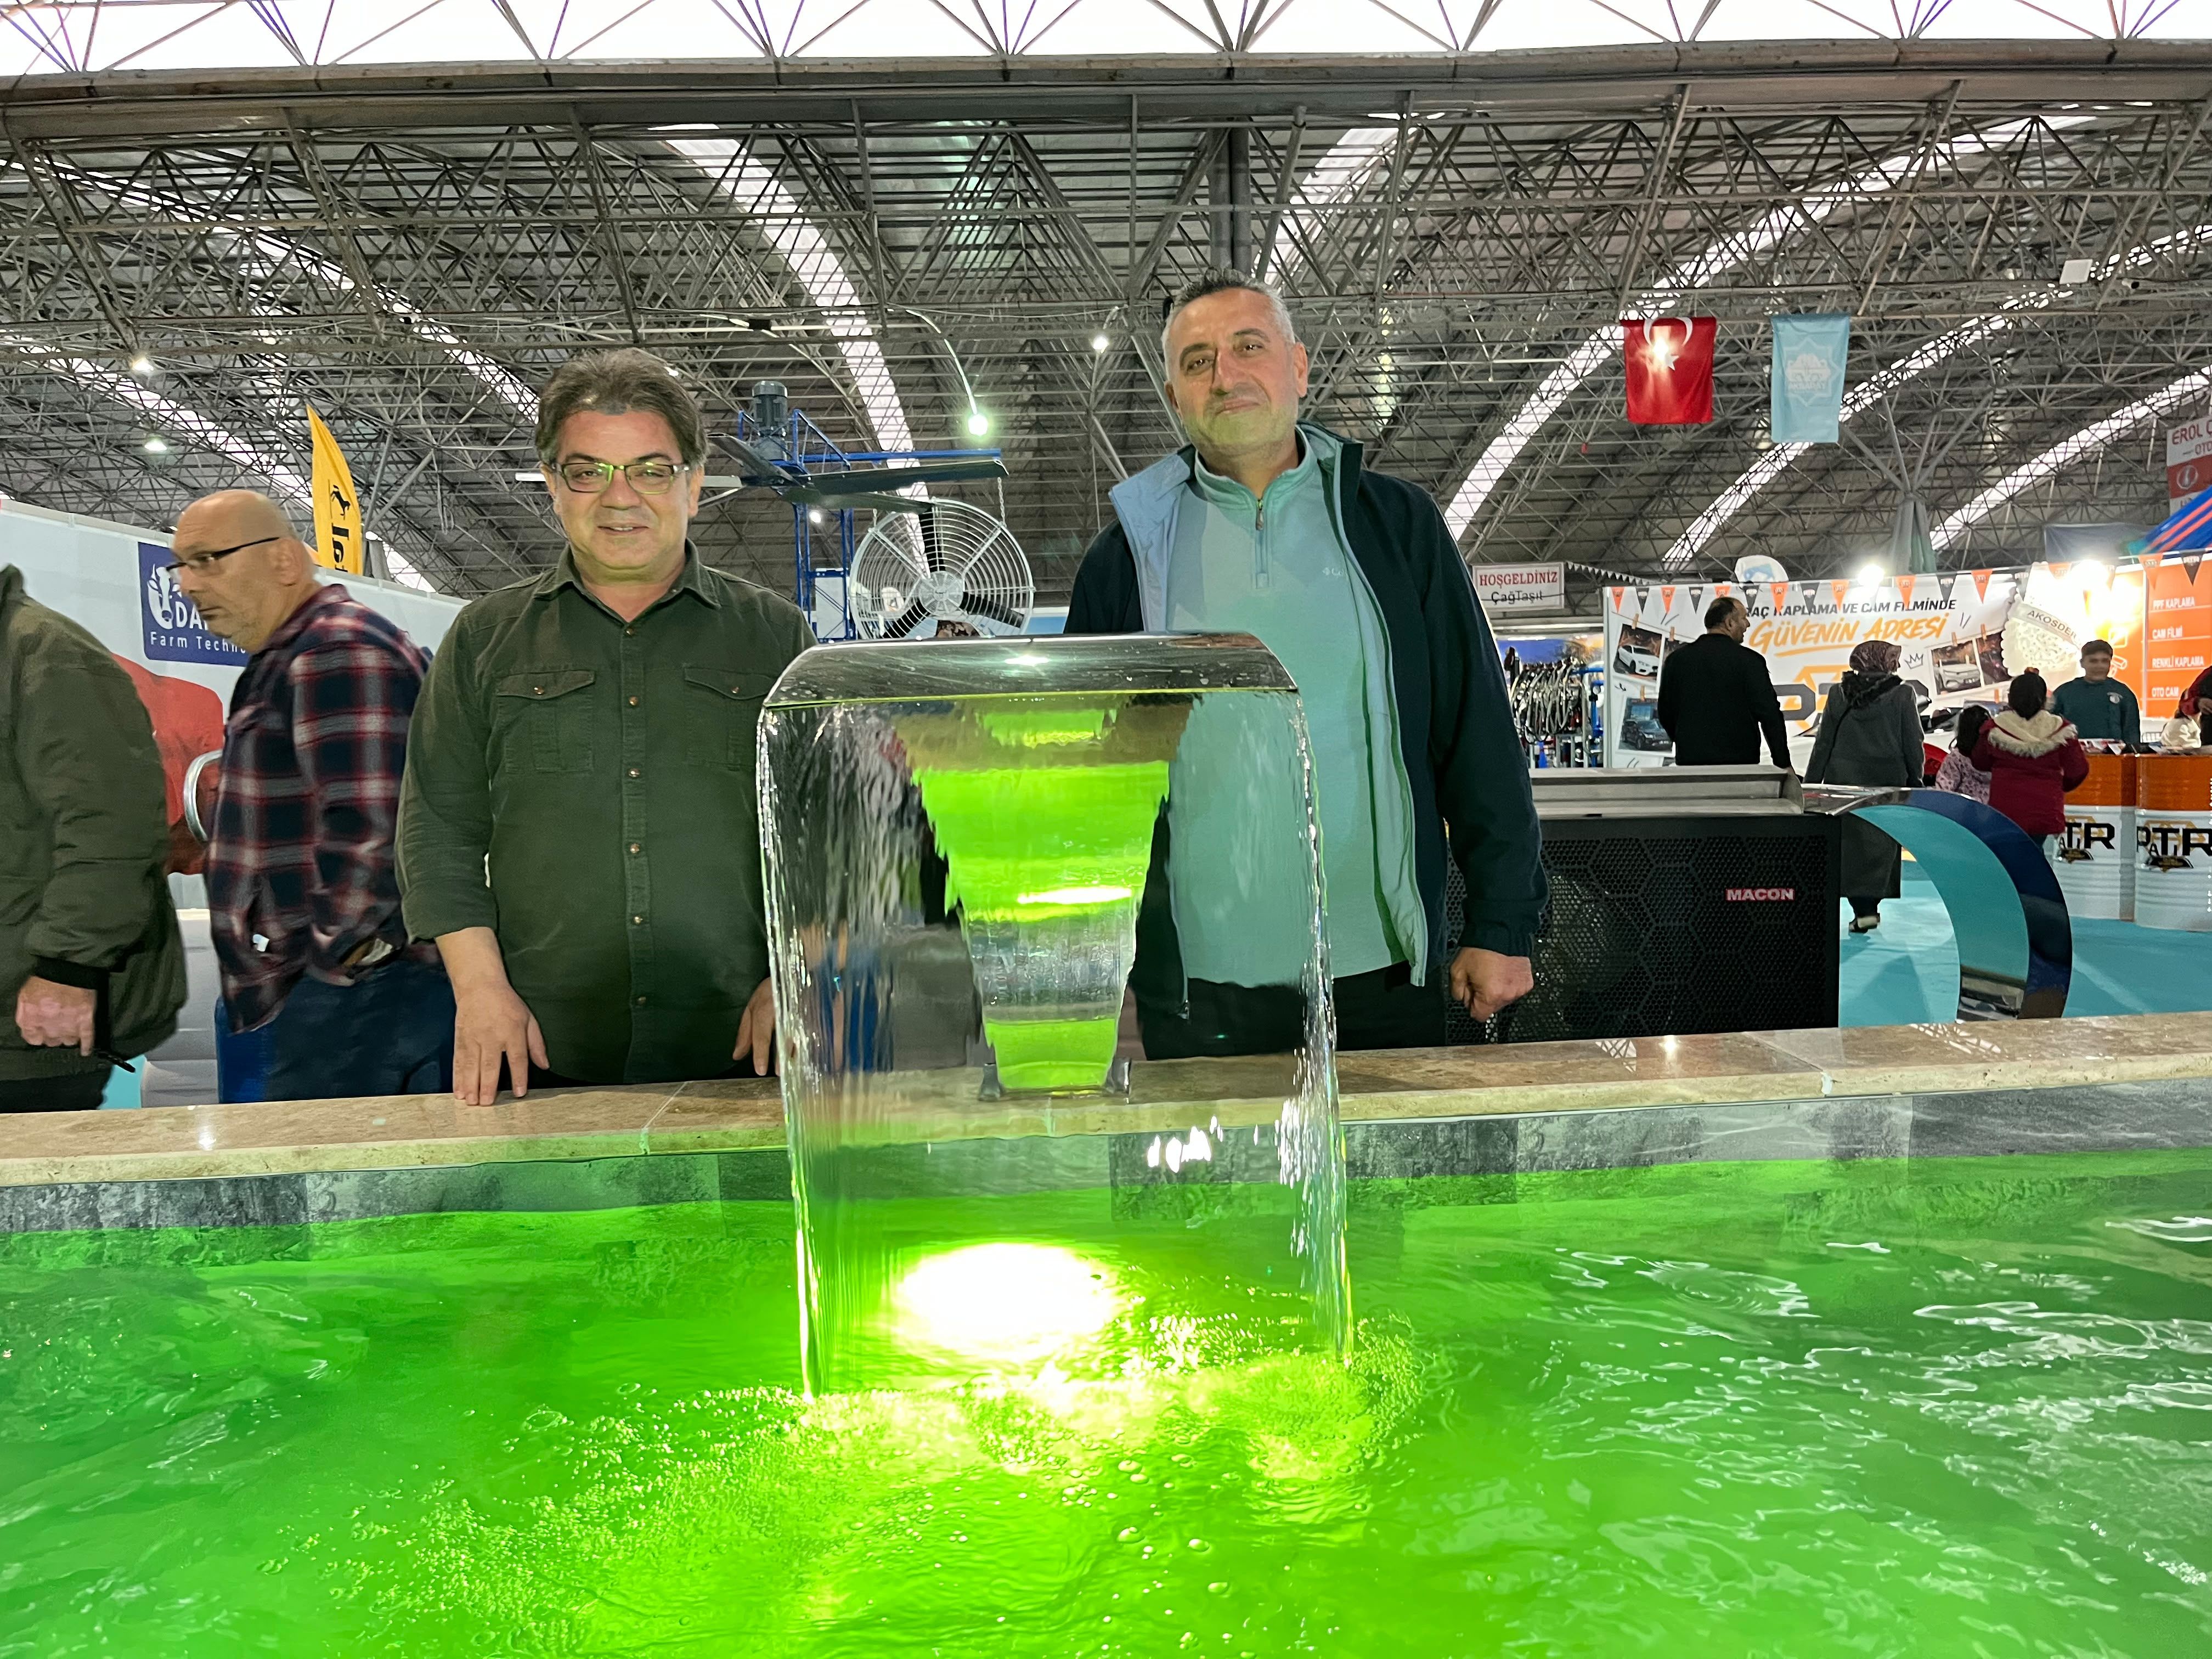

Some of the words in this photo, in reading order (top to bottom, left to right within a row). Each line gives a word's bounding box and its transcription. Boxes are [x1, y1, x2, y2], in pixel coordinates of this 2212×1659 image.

[2172, 424, 2203, 445] EROL
[1479, 569, 1558, 589] HOŞGELDİNİZ
[1842, 603, 1859, 613] VE
[2165, 596, 2195, 608] KAPLAMA
[175, 601, 208, 631] DA
[150, 631, 187, 648] Farm
[1748, 618, 1860, 654] GÜVENİN
[1862, 612, 1950, 641] ADRESİ
[2152, 628, 2166, 640] CAM
[2152, 656, 2174, 668] RENKLİ
[2175, 656, 2204, 667] KAPLAMA
[2152, 687, 2164, 697] OTO
[2165, 686, 2179, 697] CAM
[2064, 822, 2115, 849] TR
[2137, 826, 2212, 856] PTR
[1726, 888, 1795, 901] MACON
